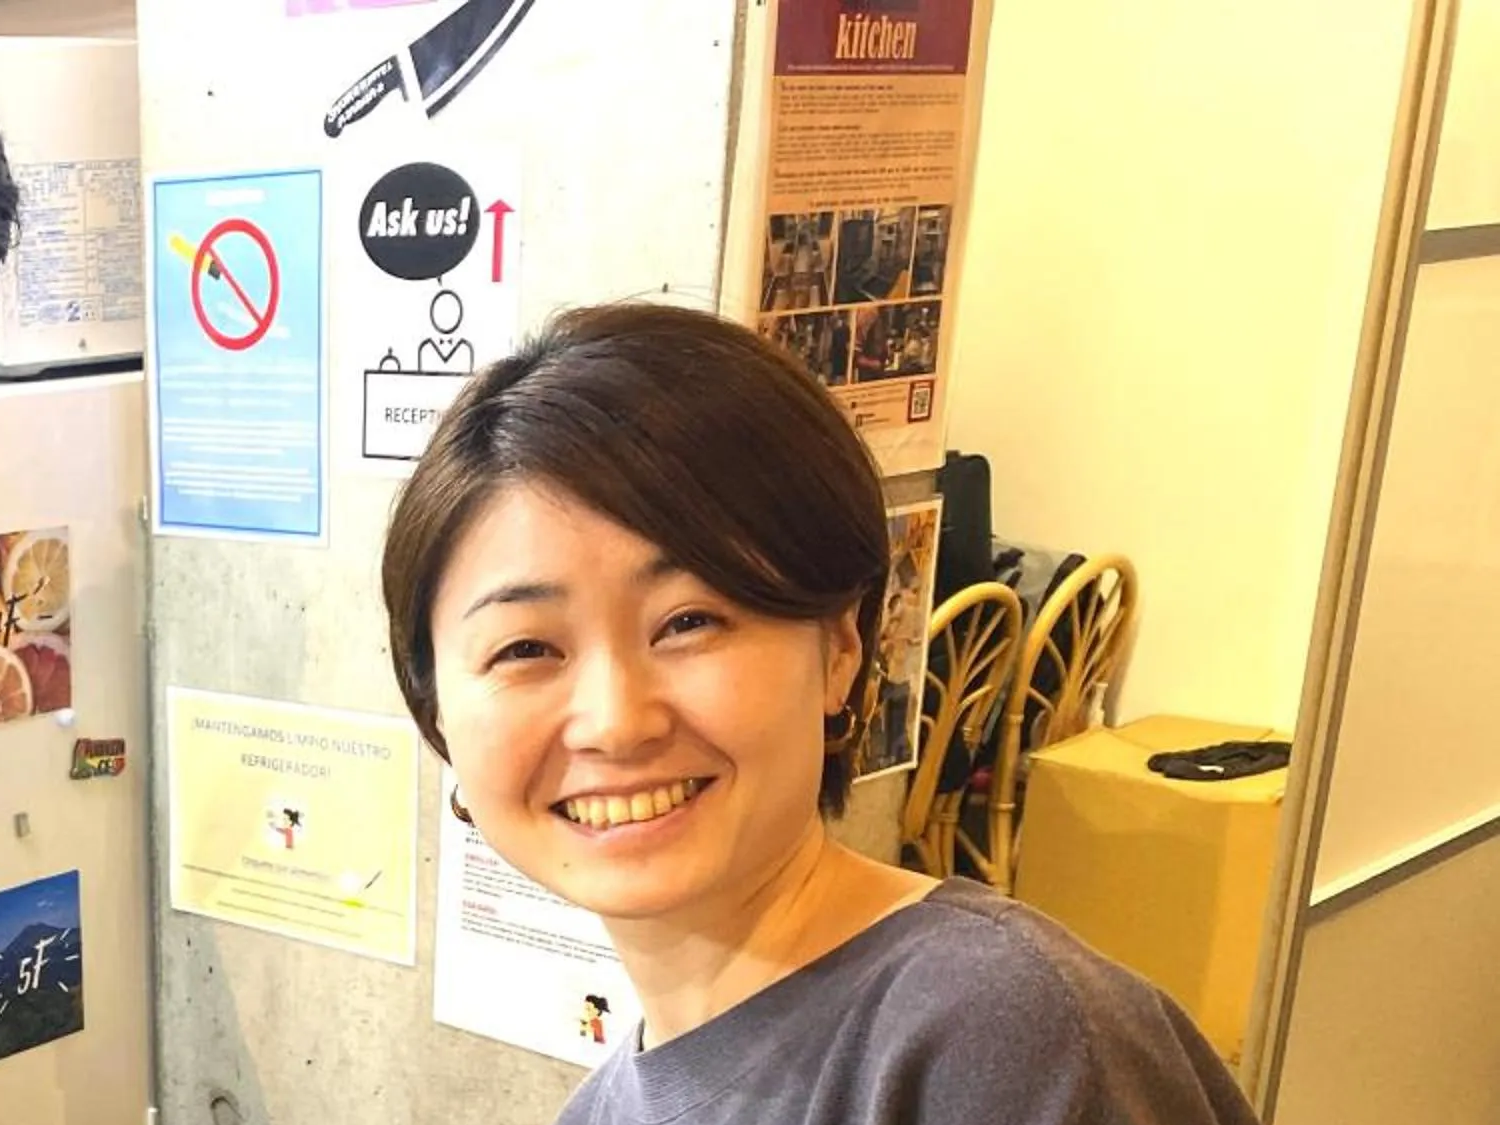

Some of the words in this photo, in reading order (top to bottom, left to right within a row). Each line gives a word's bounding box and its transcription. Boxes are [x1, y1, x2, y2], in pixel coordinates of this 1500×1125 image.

[835, 12, 918, 59] kitchen
[366, 197, 419, 238] Ask
[424, 196, 472, 236] us!
[384, 407, 438, 426] RECEPT
[16, 936, 57, 995] 5F
